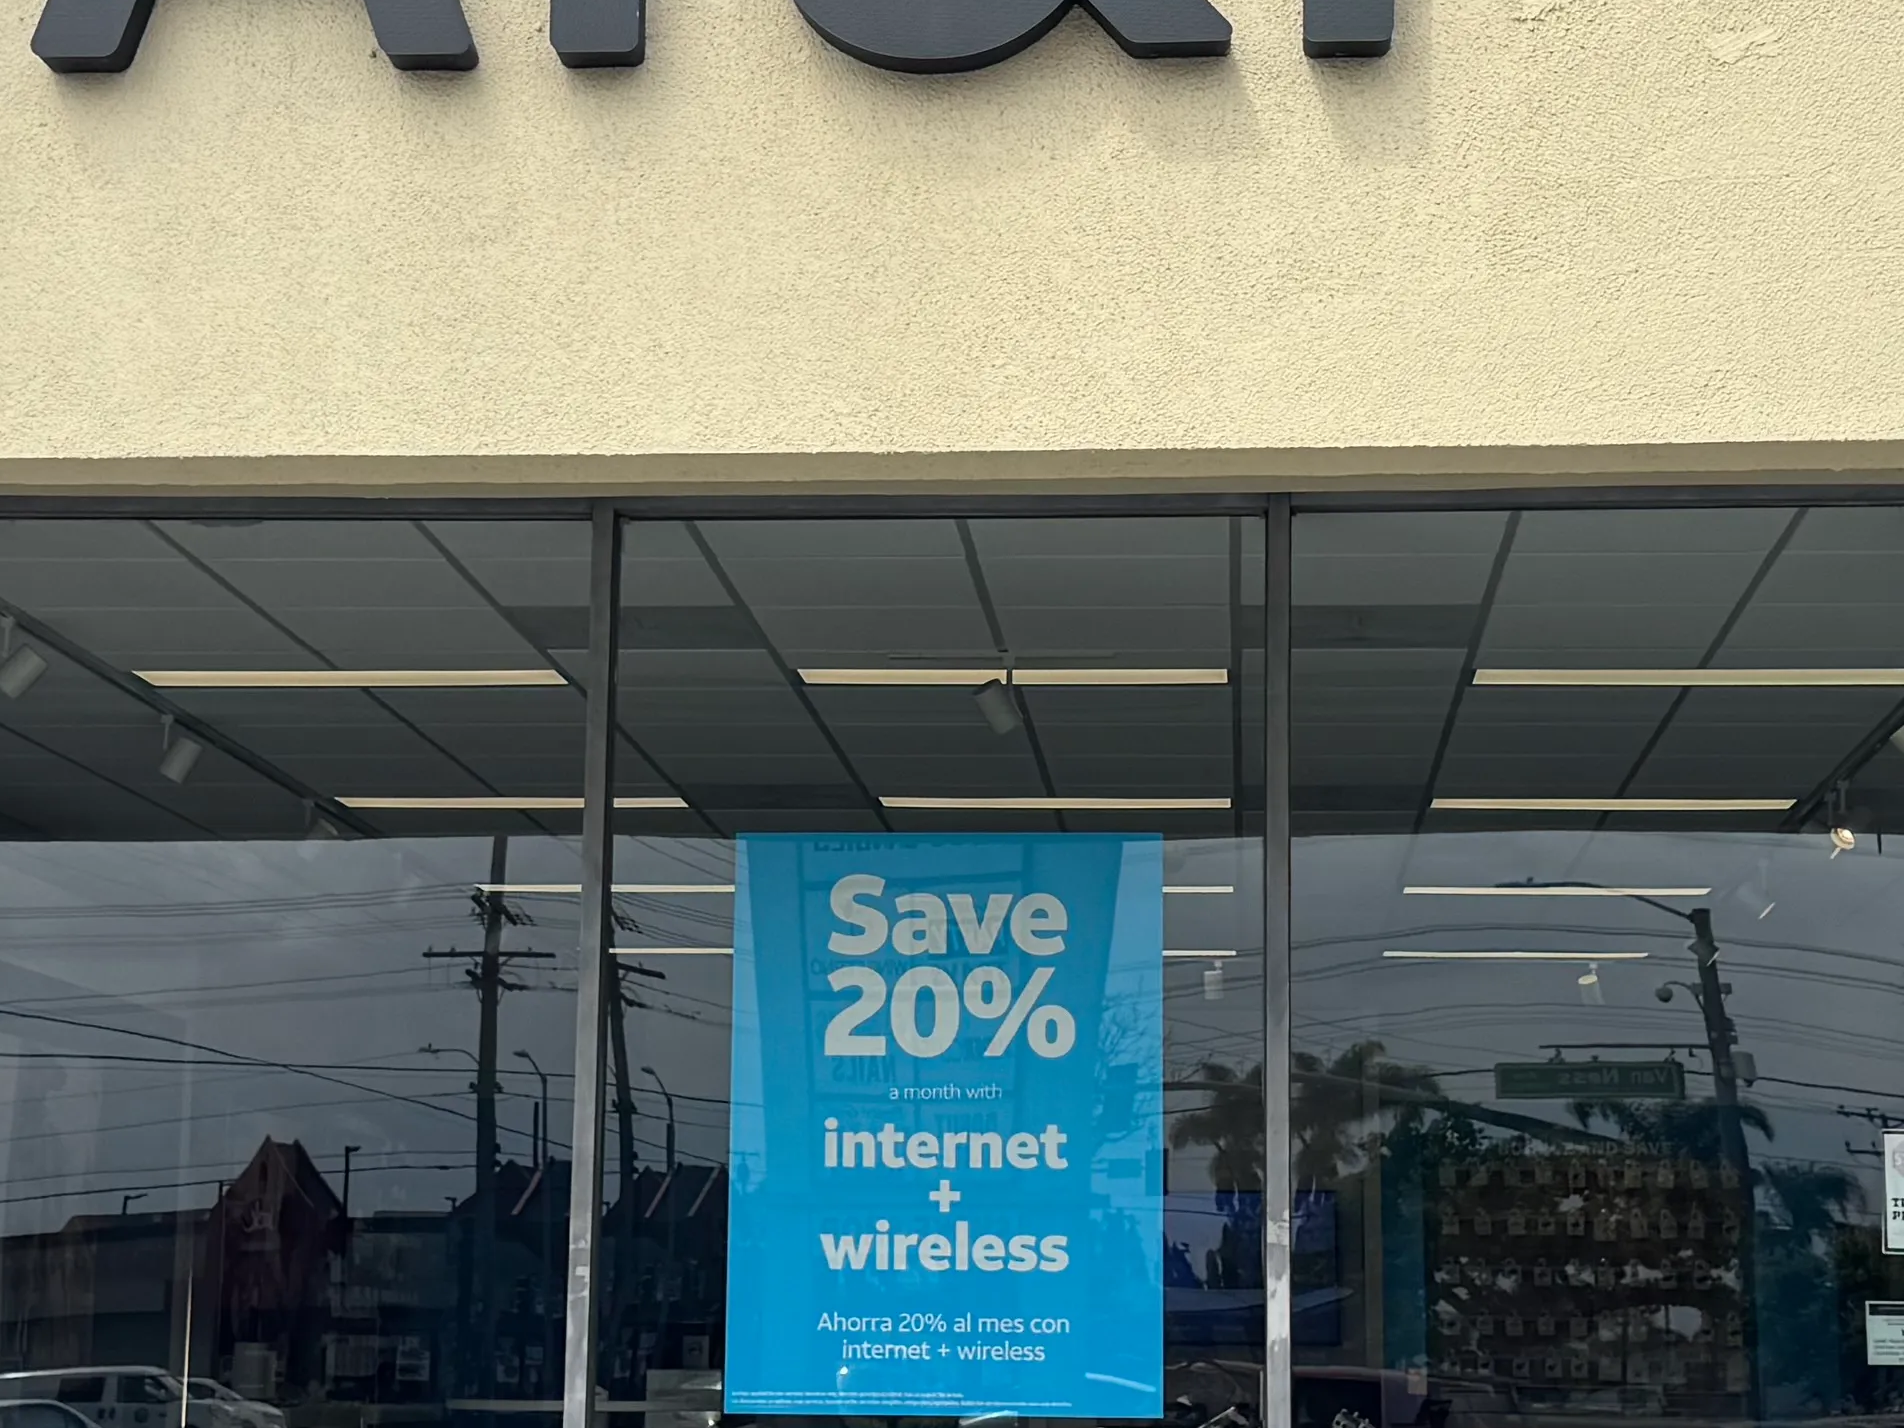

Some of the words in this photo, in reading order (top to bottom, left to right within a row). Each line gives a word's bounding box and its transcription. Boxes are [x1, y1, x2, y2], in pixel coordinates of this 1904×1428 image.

[827, 873, 1069, 956] Save
[823, 965, 1076, 1059] 20%
[889, 1087, 900, 1100] a
[904, 1083, 962, 1100] month
[965, 1082, 1003, 1100] with
[824, 1117, 1069, 1169] internet
[929, 1179, 961, 1212] +
[820, 1219, 1070, 1272] wireless
[817, 1311, 894, 1333] Ahorra
[898, 1312, 949, 1334] 20%
[953, 1311, 973, 1334] al
[977, 1317, 1025, 1334] mes
[1029, 1318, 1071, 1334] con
[841, 1339, 932, 1361] internet
[956, 1340, 1046, 1363] wireless
